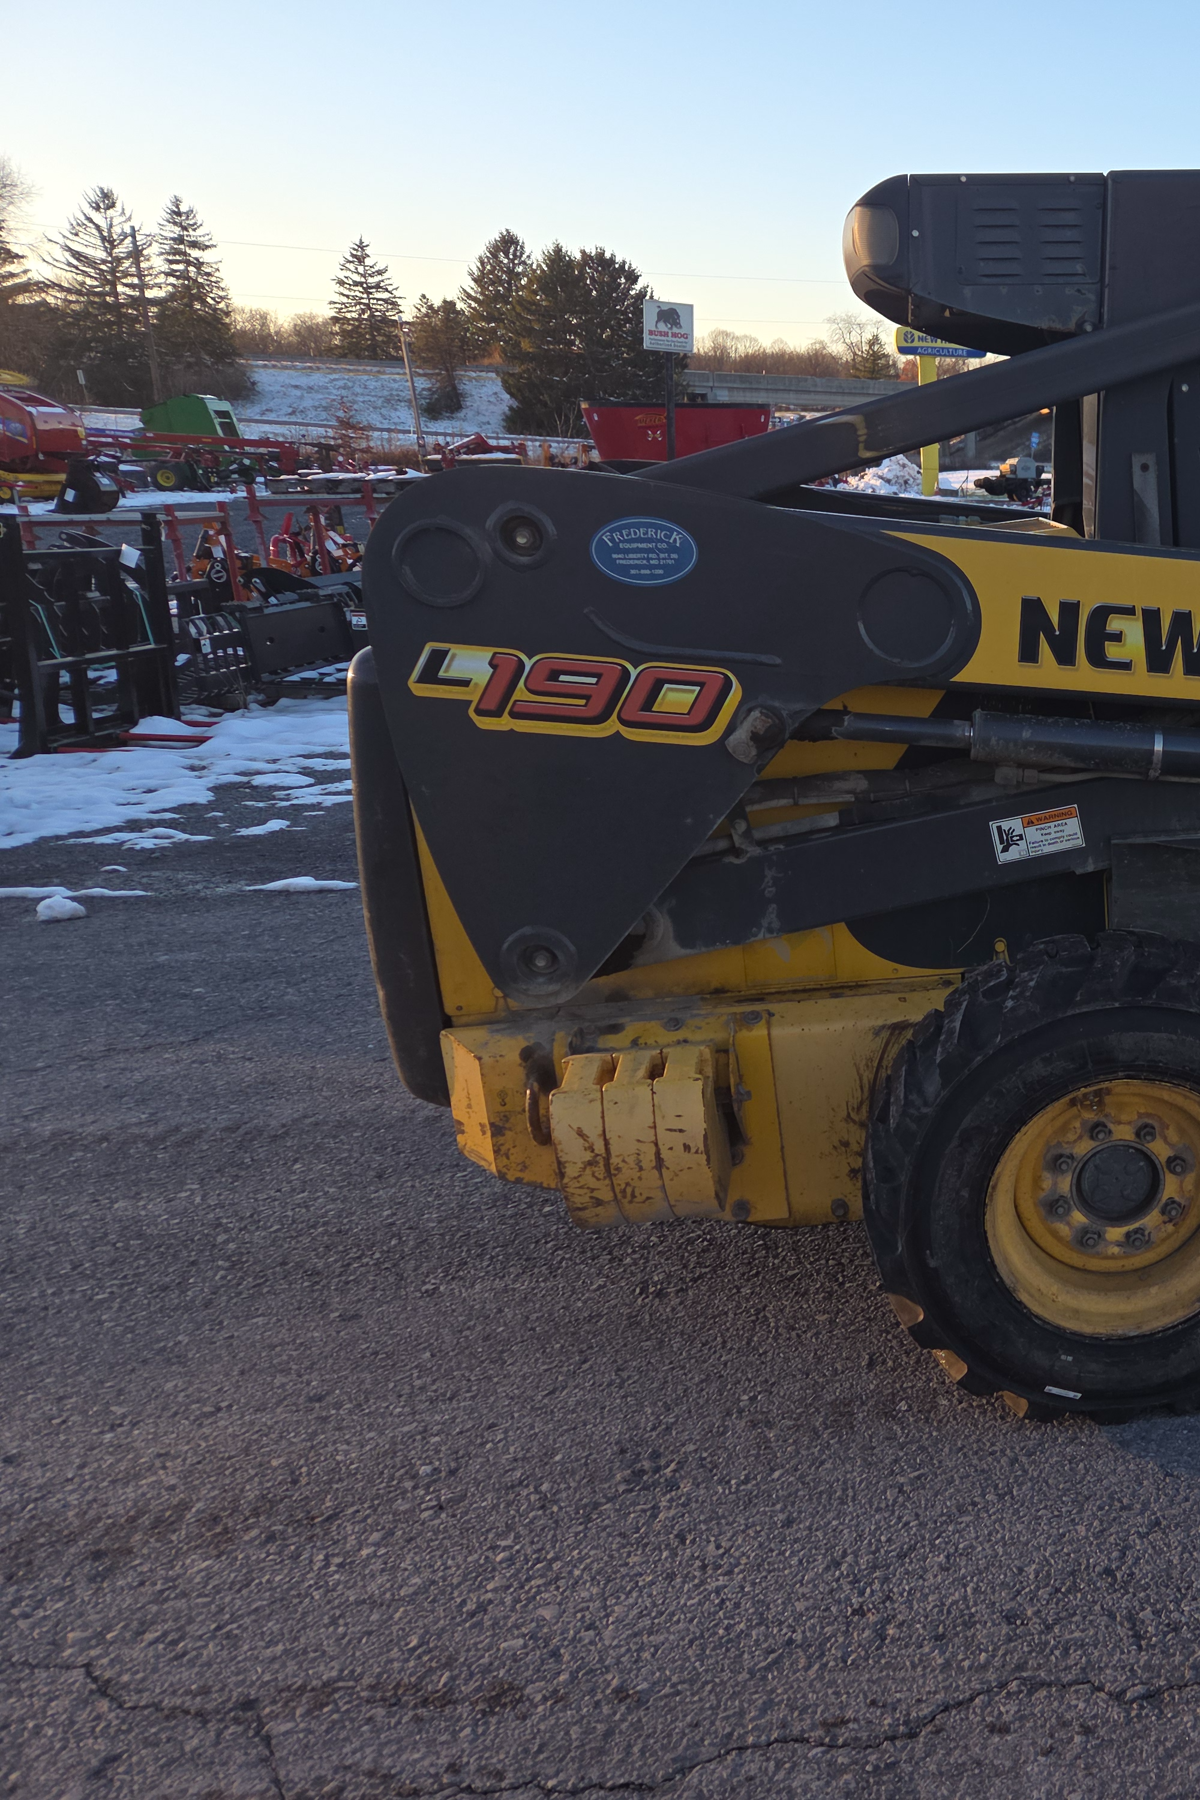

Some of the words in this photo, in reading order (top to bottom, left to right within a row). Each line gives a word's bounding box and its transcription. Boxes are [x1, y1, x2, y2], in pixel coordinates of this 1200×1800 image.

[648, 329, 669, 338] BUSH
[671, 332, 688, 340] HOG
[917, 335, 938, 344] NEW
[917, 347, 968, 356] AGRICULTURE
[602, 528, 686, 547] FREDERICK
[411, 644, 738, 738] L190
[1035, 810, 1073, 823] WARNING
